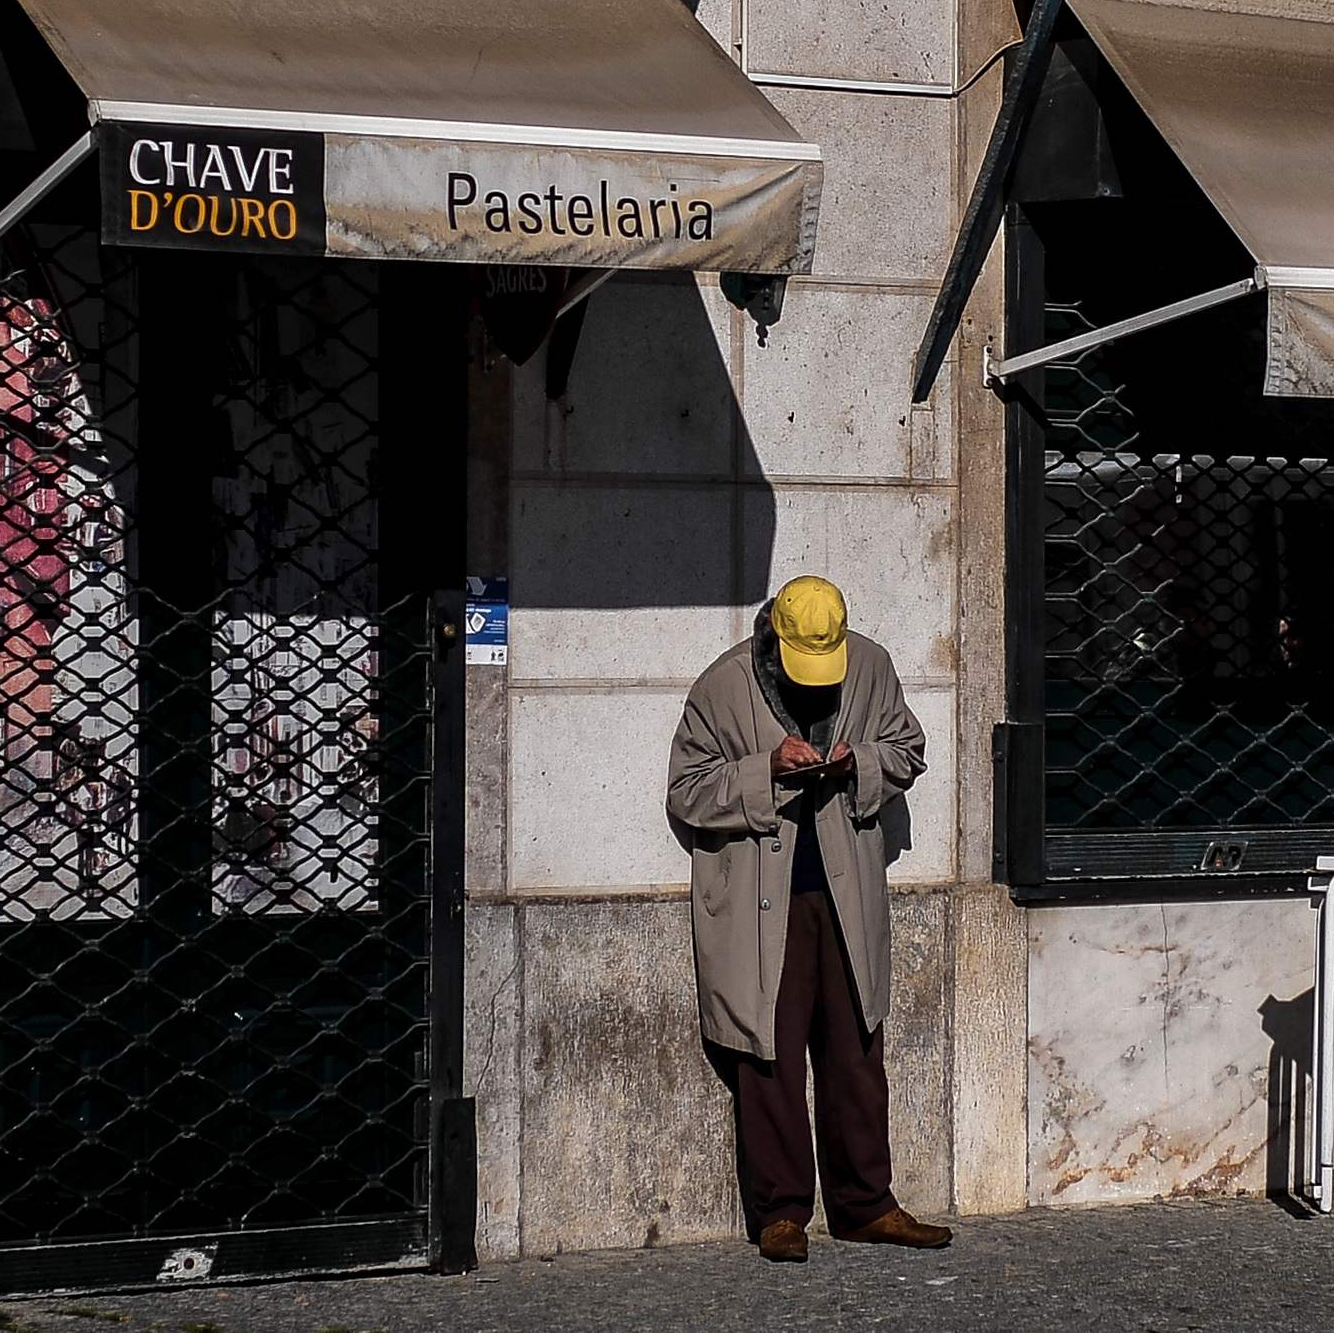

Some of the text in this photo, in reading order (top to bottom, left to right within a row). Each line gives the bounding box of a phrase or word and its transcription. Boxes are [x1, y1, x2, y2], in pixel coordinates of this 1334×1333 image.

[130, 138, 294, 195] CHAVE
[131, 191, 298, 240] D'OURO
[447, 172, 714, 243] Pastelaria
